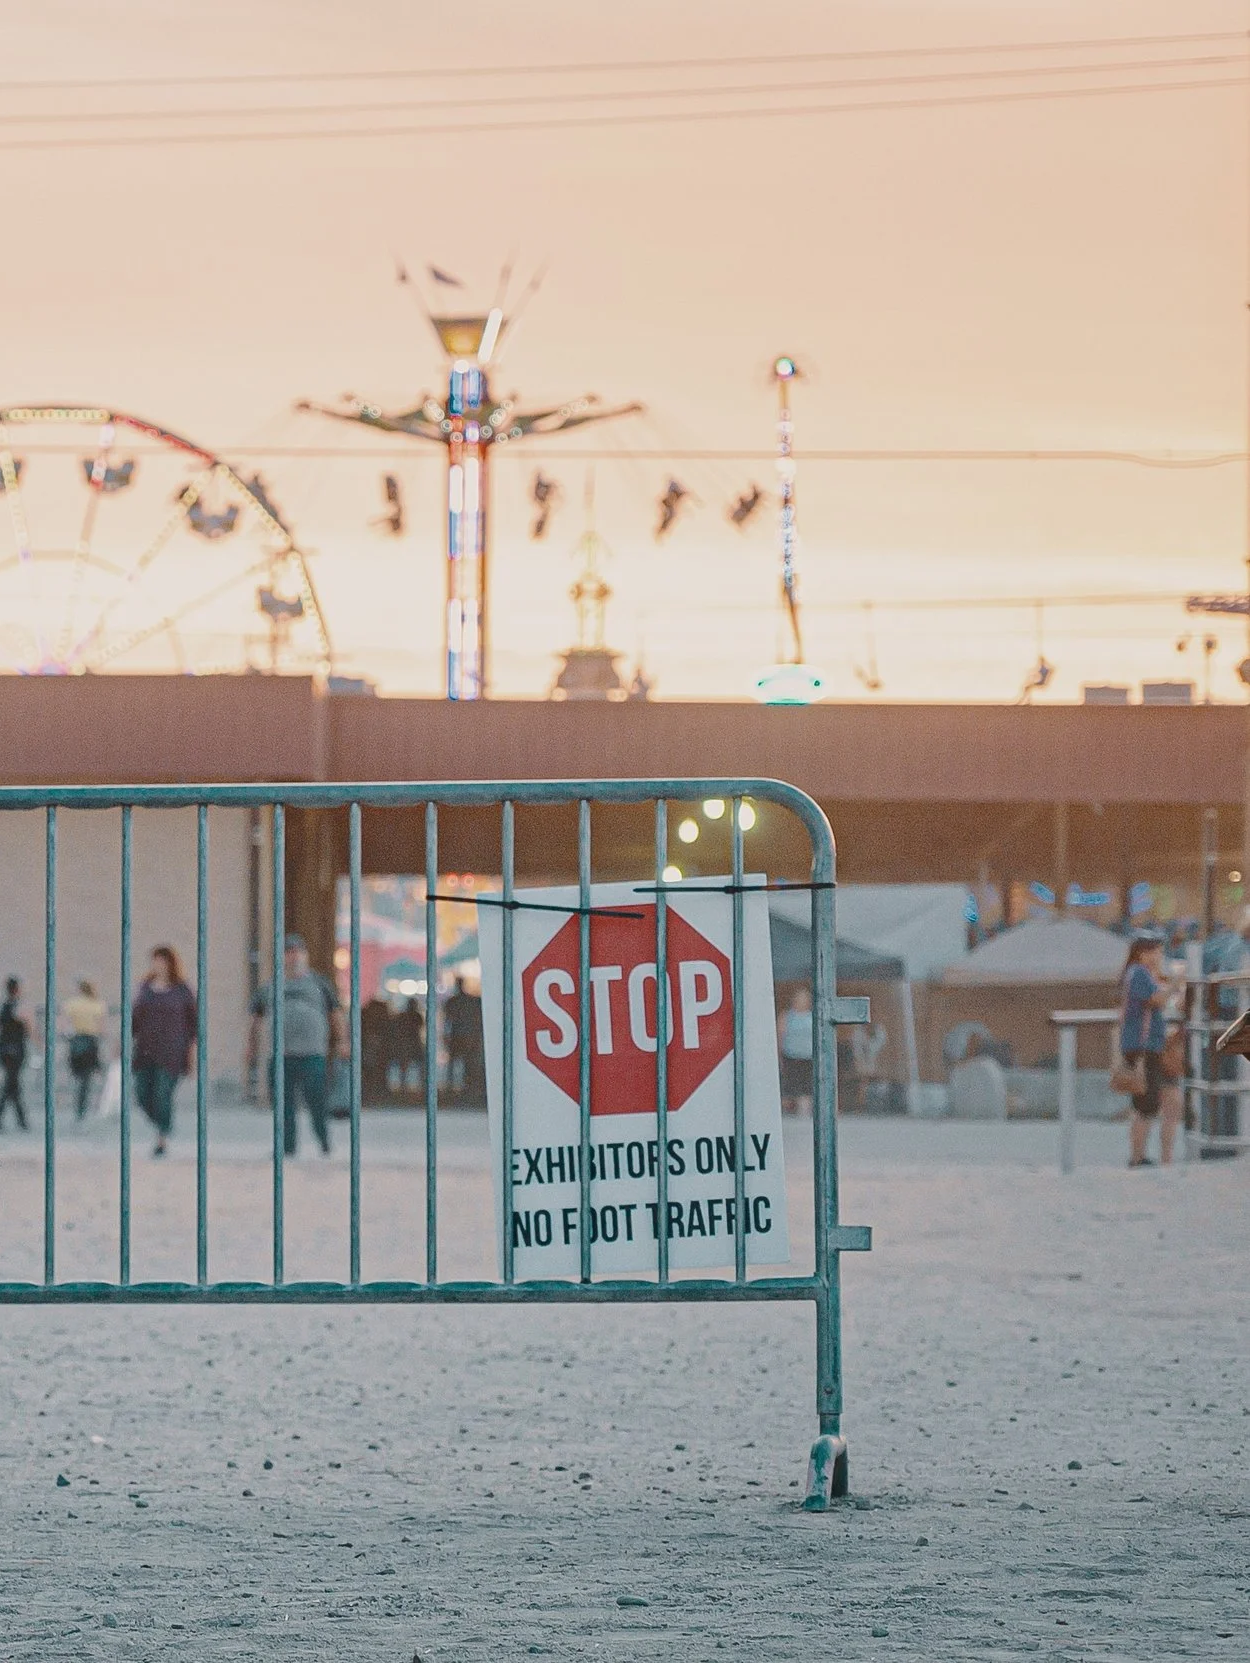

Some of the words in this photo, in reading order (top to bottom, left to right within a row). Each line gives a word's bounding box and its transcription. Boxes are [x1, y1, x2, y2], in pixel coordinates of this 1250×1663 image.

[533, 960, 723, 1059] STOP
[511, 1209, 553, 1248] NO
[562, 1204, 638, 1245] FOOT
[645, 1196, 772, 1240] TRAFFIC
